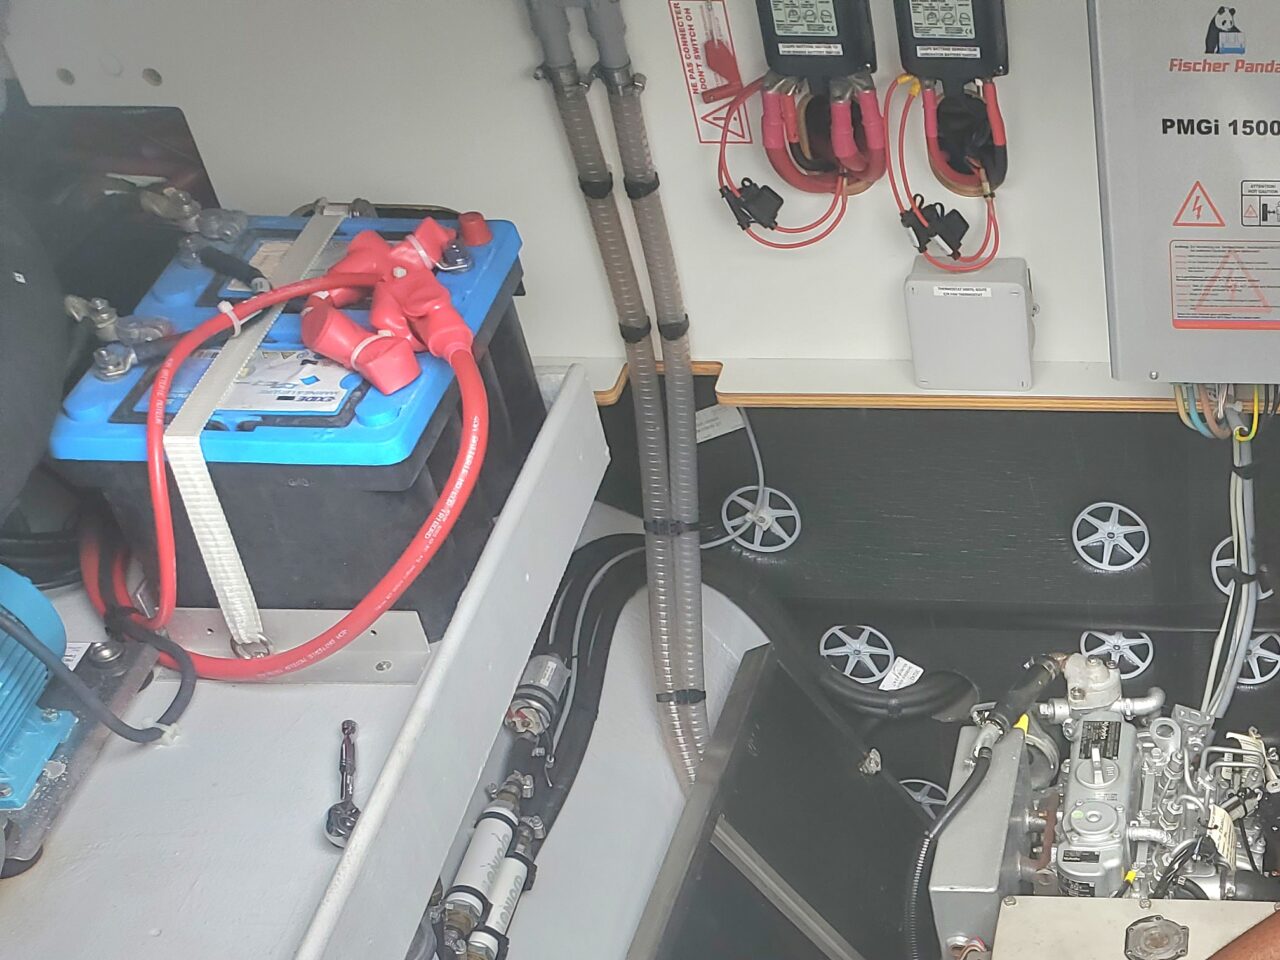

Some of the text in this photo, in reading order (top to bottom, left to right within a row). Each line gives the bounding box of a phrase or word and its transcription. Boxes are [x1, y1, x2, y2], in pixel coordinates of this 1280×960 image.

[674, 2, 692, 60] CONNECTER
[688, 24, 702, 60] SWITCH
[687, 63, 696, 80] PAS
[1168, 58, 1230, 72] Fischer
[1162, 118, 1220, 136] PMGi
